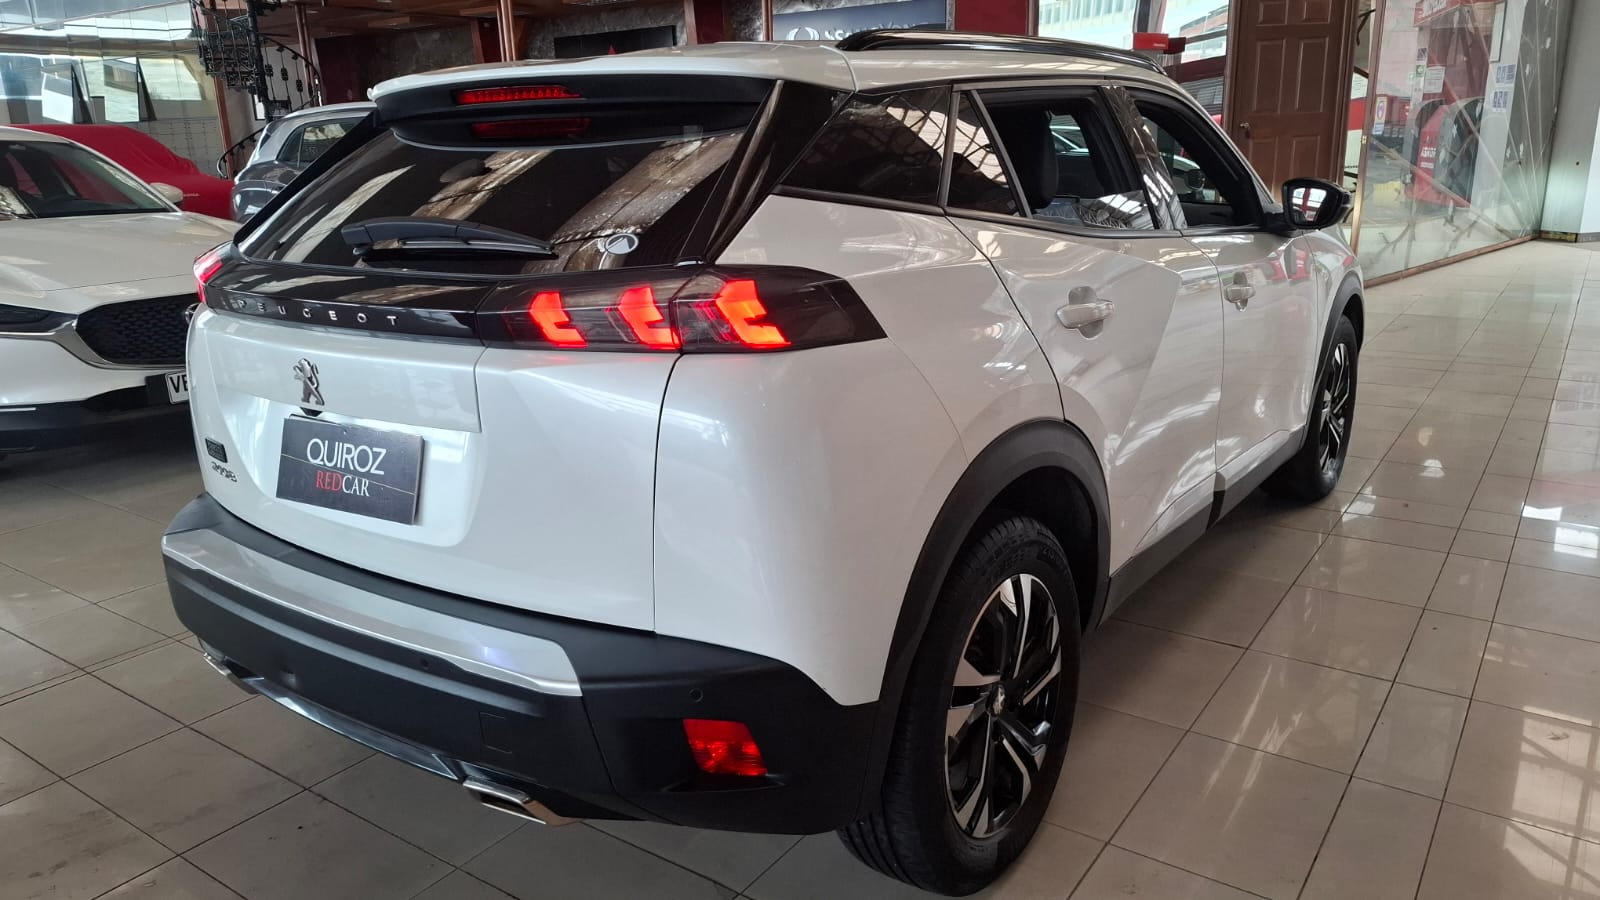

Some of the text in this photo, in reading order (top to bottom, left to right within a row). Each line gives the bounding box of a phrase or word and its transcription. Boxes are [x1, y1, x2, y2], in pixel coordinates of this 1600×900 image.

[238, 299, 397, 326] PEUGEOT
[306, 438, 387, 475] QUIROZ
[315, 469, 370, 497] REDCAR
